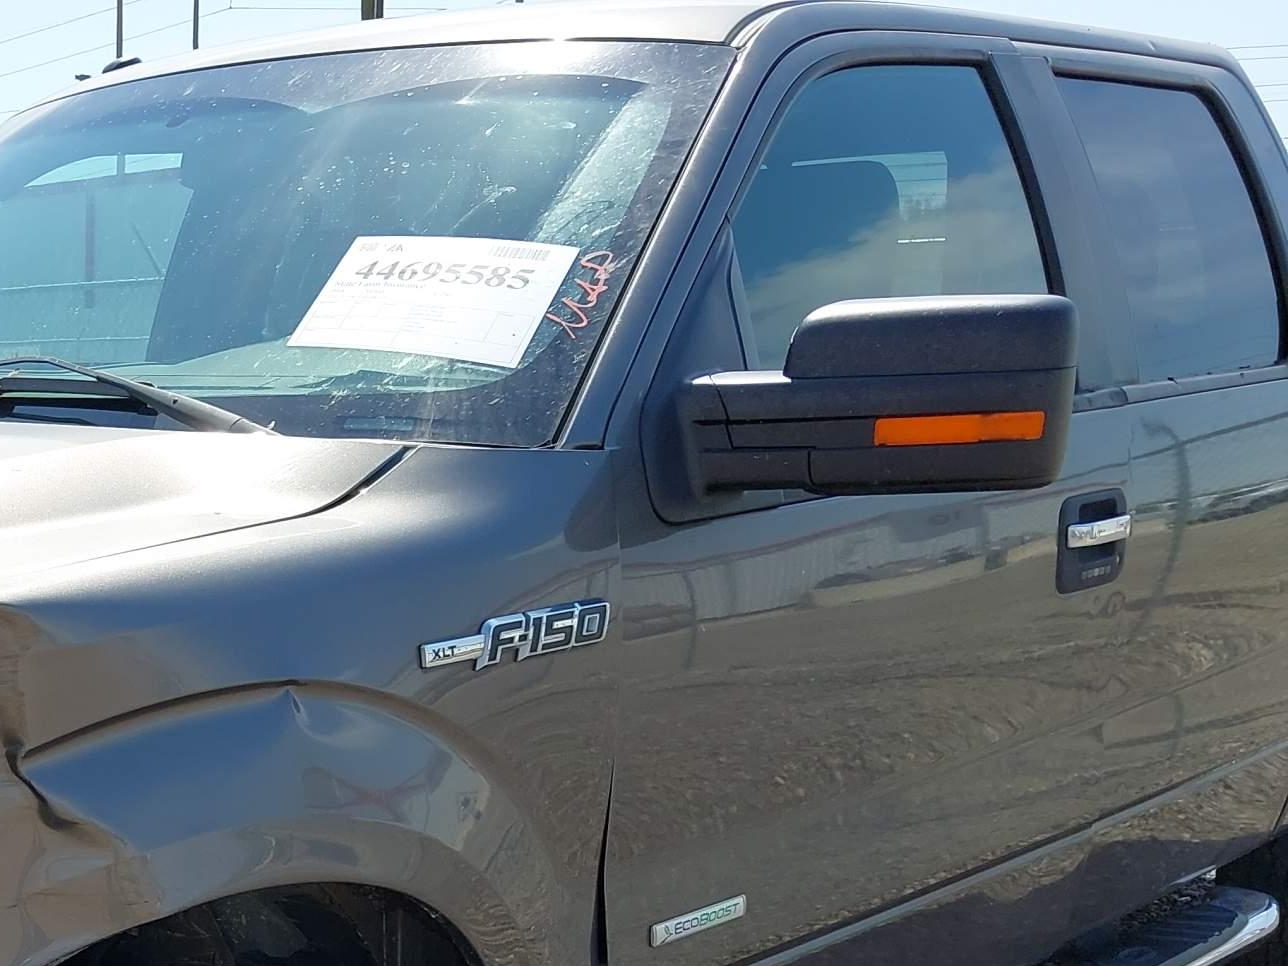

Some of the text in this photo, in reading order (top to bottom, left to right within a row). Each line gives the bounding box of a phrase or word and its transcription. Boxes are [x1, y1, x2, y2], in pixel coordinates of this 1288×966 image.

[355, 259, 536, 290] 44695585
[431, 601, 611, 672] XLT F-150
